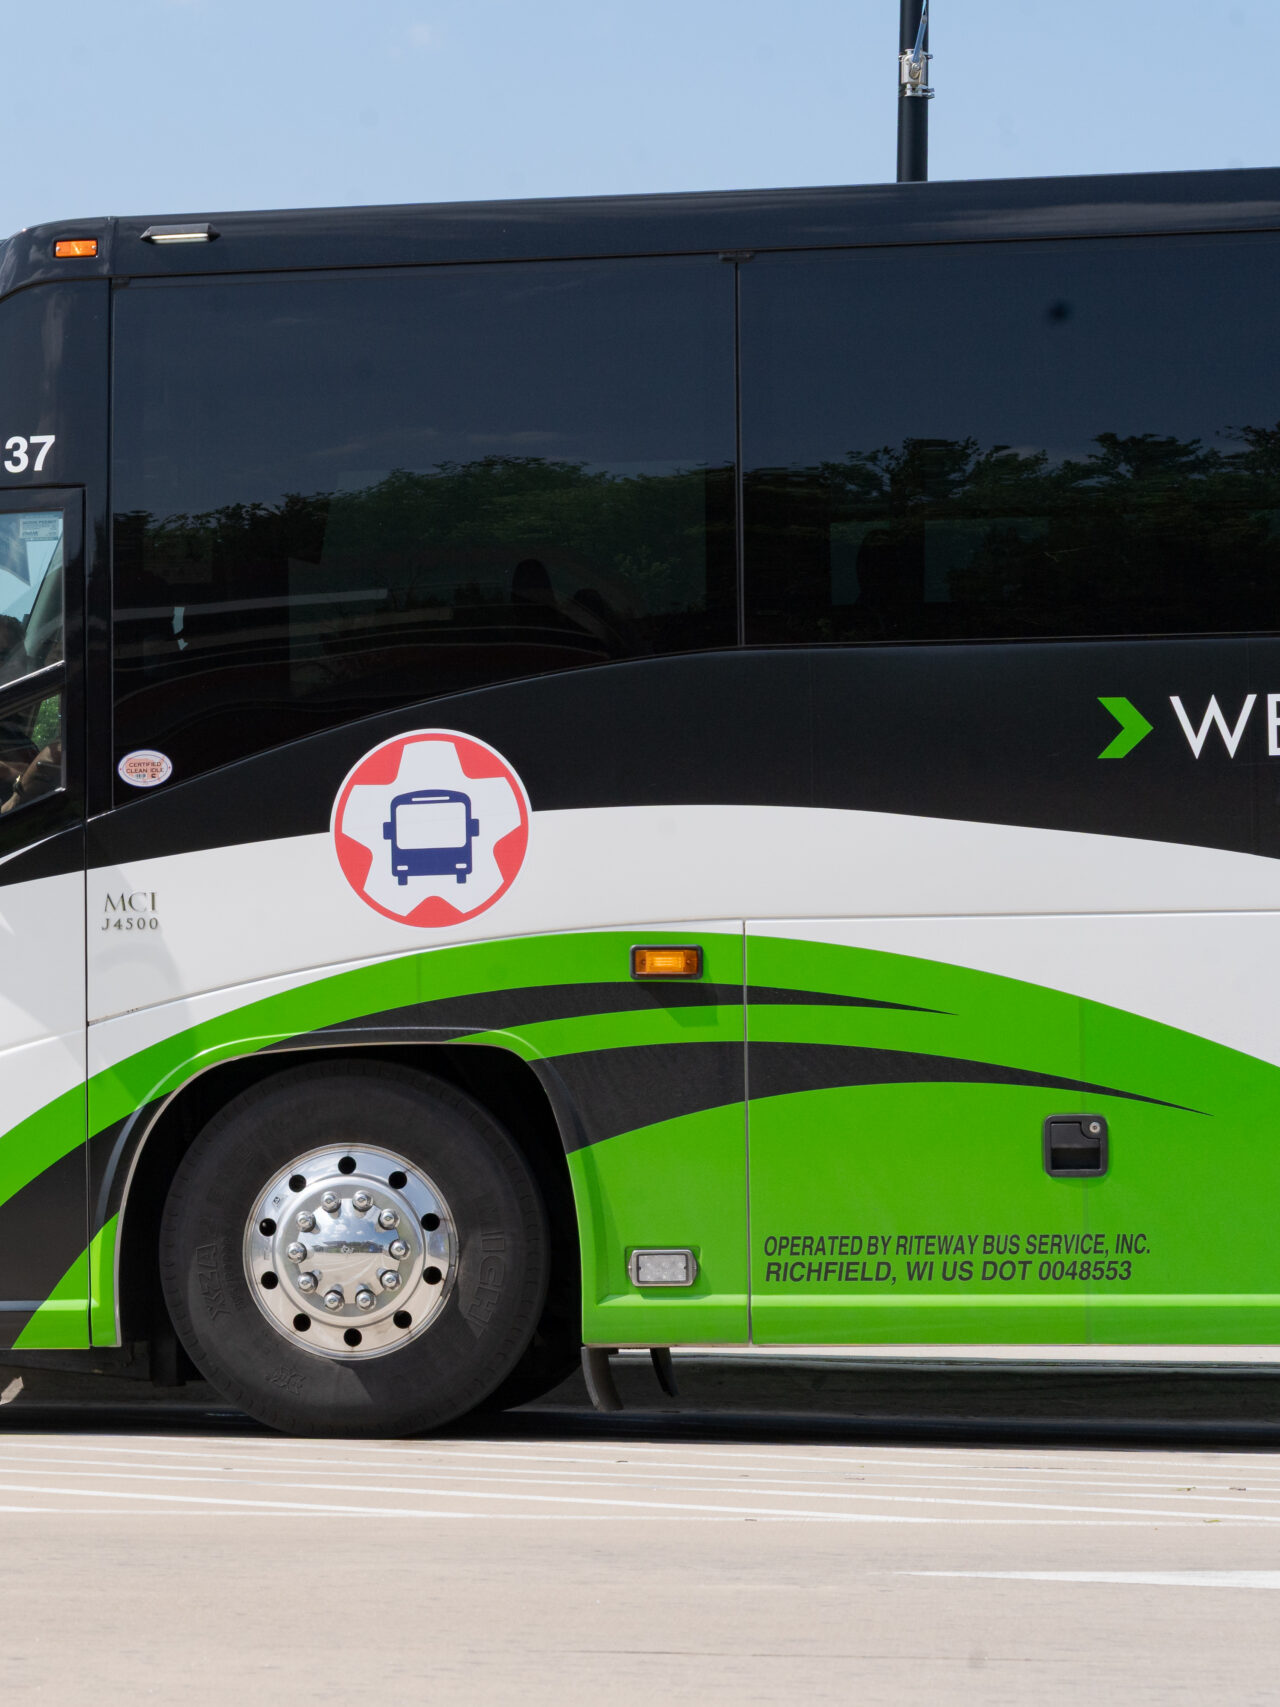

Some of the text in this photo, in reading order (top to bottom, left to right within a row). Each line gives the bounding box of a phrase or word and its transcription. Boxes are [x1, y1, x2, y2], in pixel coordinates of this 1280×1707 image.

[104, 891, 157, 912] MCI
[101, 917, 159, 931] J4500
[764, 1233, 1151, 1258] OPERATED BY RITEWAY BUS SERVICE, INC.
[765, 1260, 1132, 1286] RICHFIELD, WI US DOT 0048553
